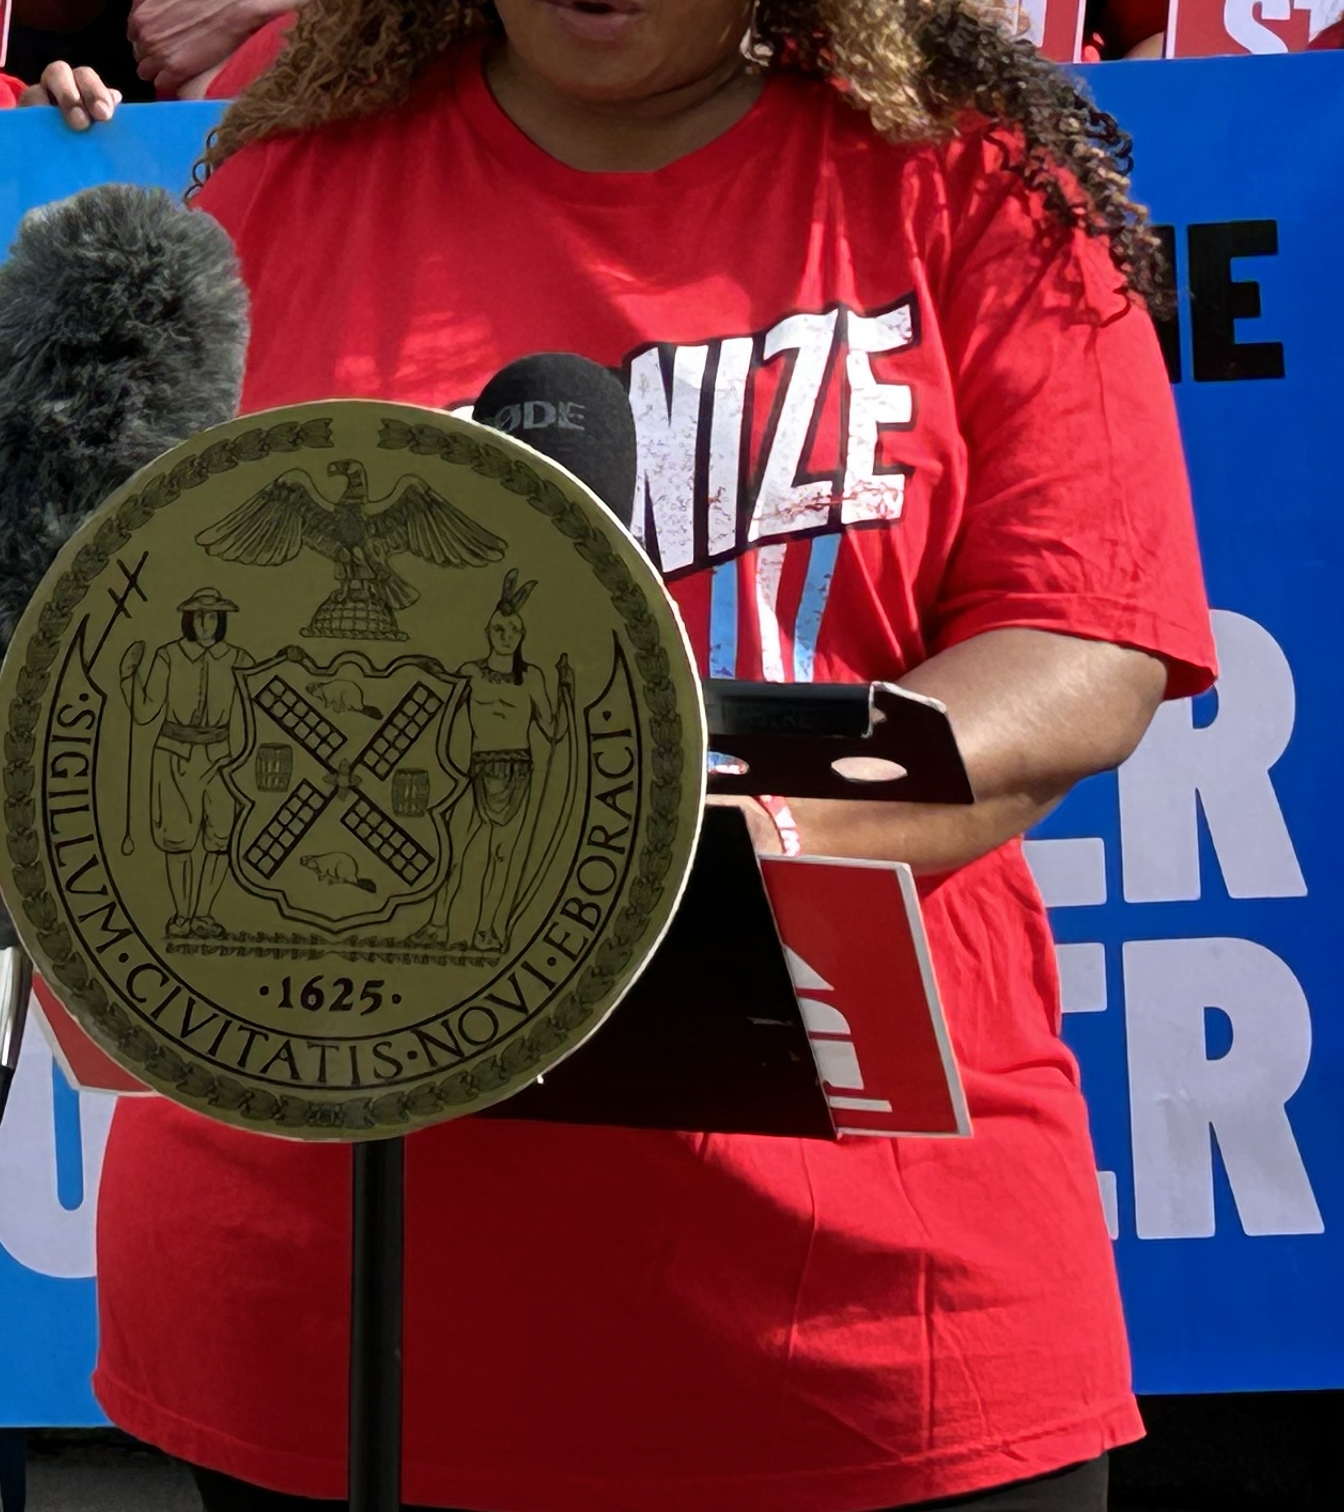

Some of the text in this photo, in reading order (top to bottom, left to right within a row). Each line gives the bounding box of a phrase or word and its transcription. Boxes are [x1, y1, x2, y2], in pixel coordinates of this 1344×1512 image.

[47, 701, 636, 1086] SIGILLVM CIVITATIS NOVI EBORACI
[277, 974, 386, 1017] 1625
